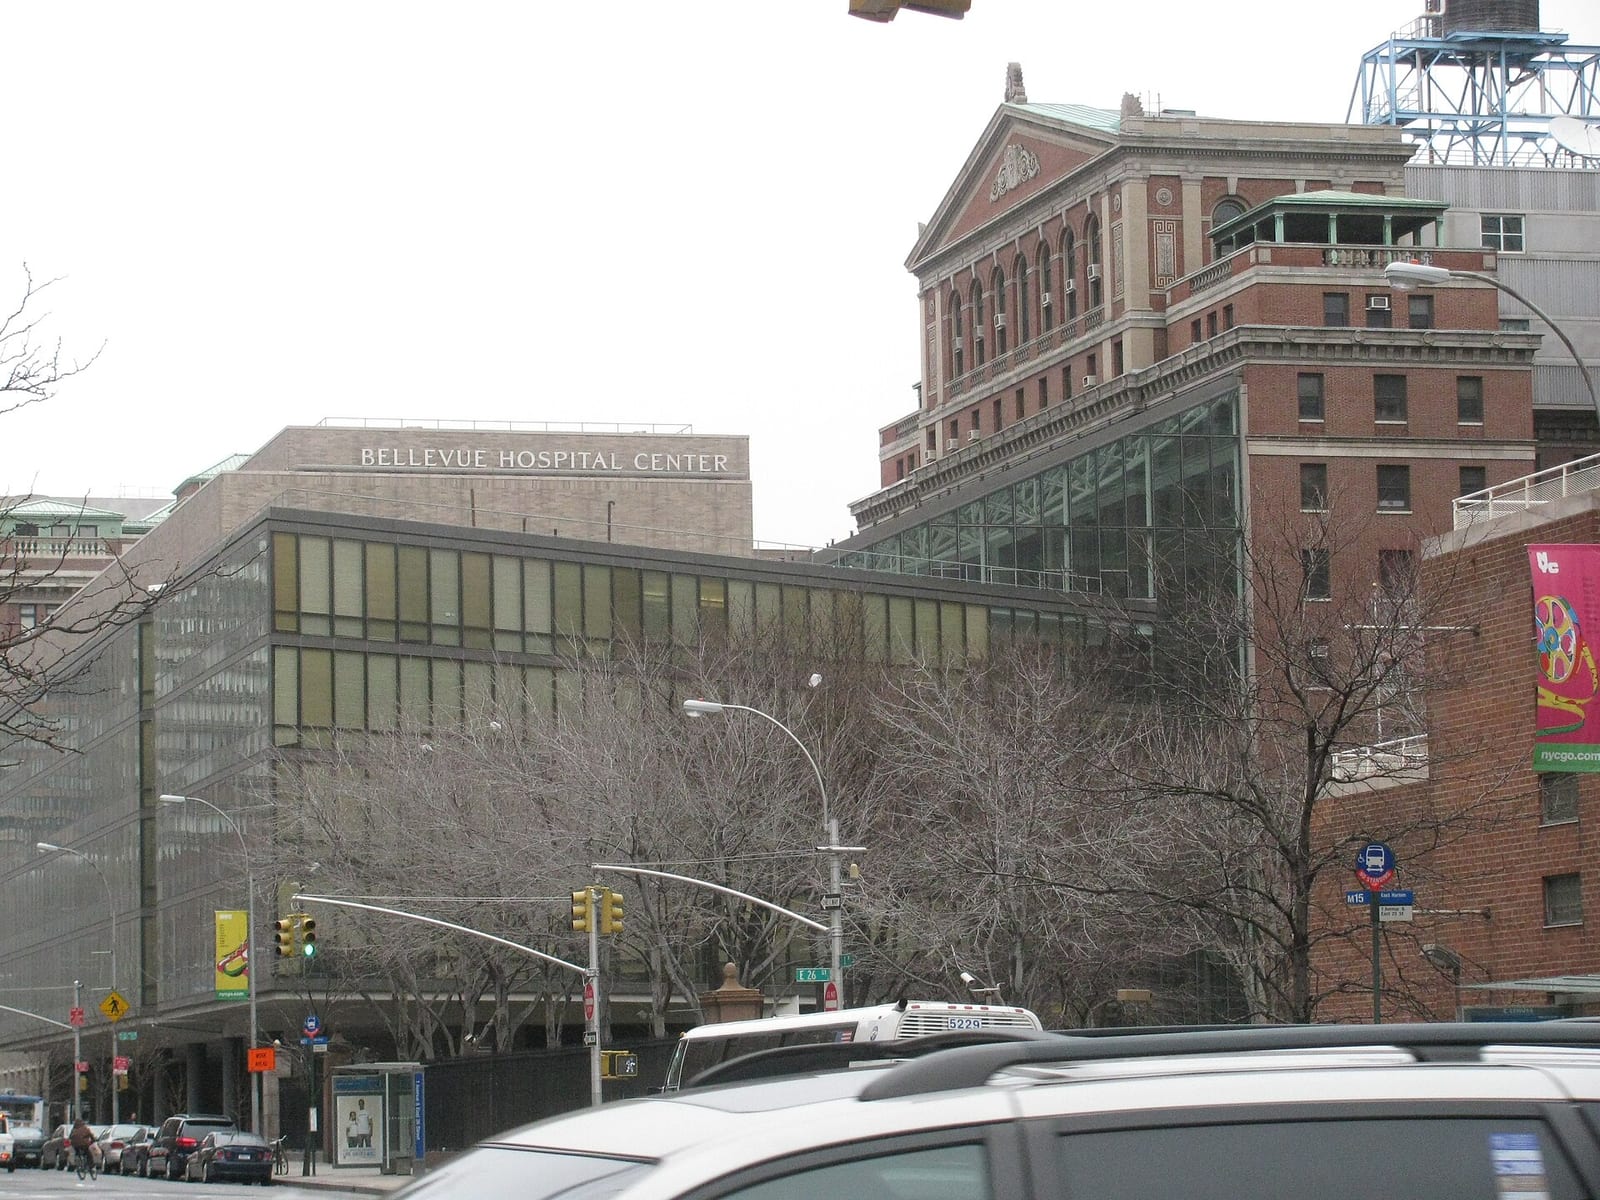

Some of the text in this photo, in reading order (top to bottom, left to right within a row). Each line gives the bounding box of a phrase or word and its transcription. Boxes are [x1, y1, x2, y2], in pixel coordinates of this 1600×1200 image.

[361, 448, 729, 472] BELLEVUE HOSPITAL CENTER
[1541, 751, 1600, 762] nycgo.com
[1347, 893, 1364, 903] M15
[799, 970, 804, 980] E
[807, 970, 817, 980] 26
[949, 1018, 980, 1029] 5229
